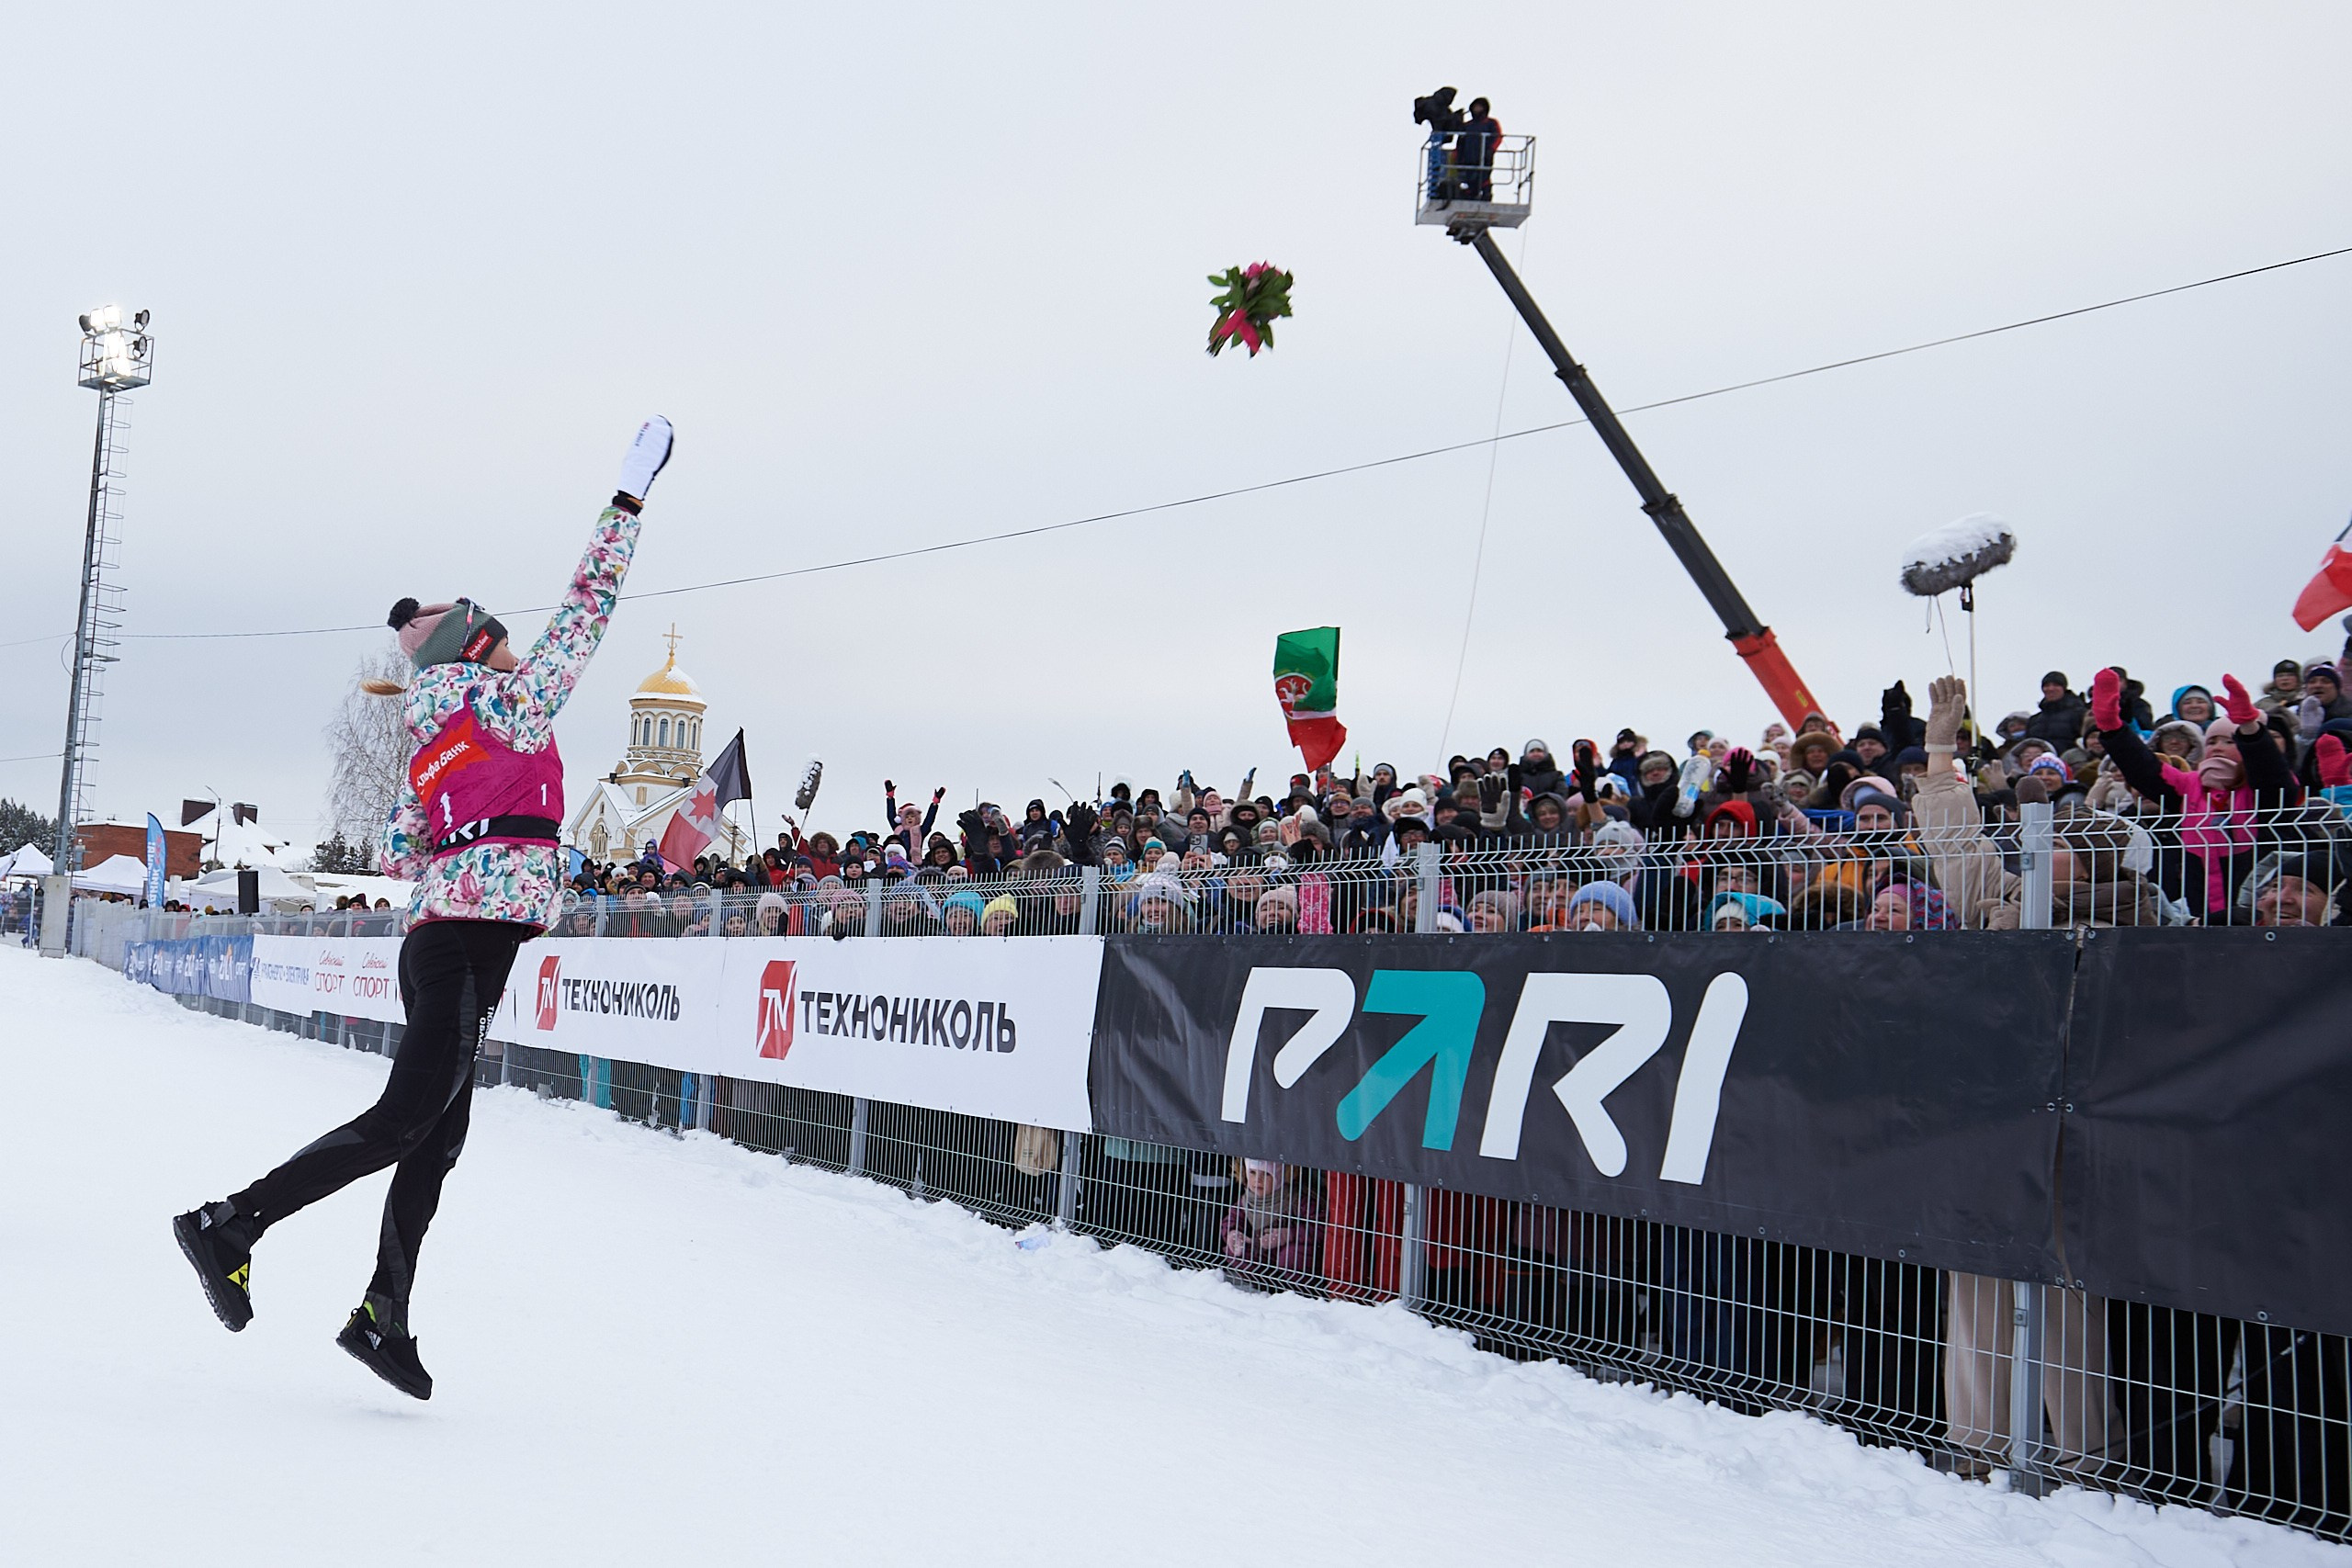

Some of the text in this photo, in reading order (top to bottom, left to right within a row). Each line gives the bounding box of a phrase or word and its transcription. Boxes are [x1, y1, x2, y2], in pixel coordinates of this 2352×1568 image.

[440, 740, 470, 766] Банк
[440, 792, 453, 829] 1
[540, 784, 548, 806] 1
[315, 972, 345, 993] СПОРТ
[353, 976, 390, 999] СПОРТ
[562, 978, 680, 1021] ТЕХНОНИКОЛЬ
[800, 991, 1016, 1053] ТЕХНОНИКОЛЬ
[1221, 966, 1749, 1185] PARI
